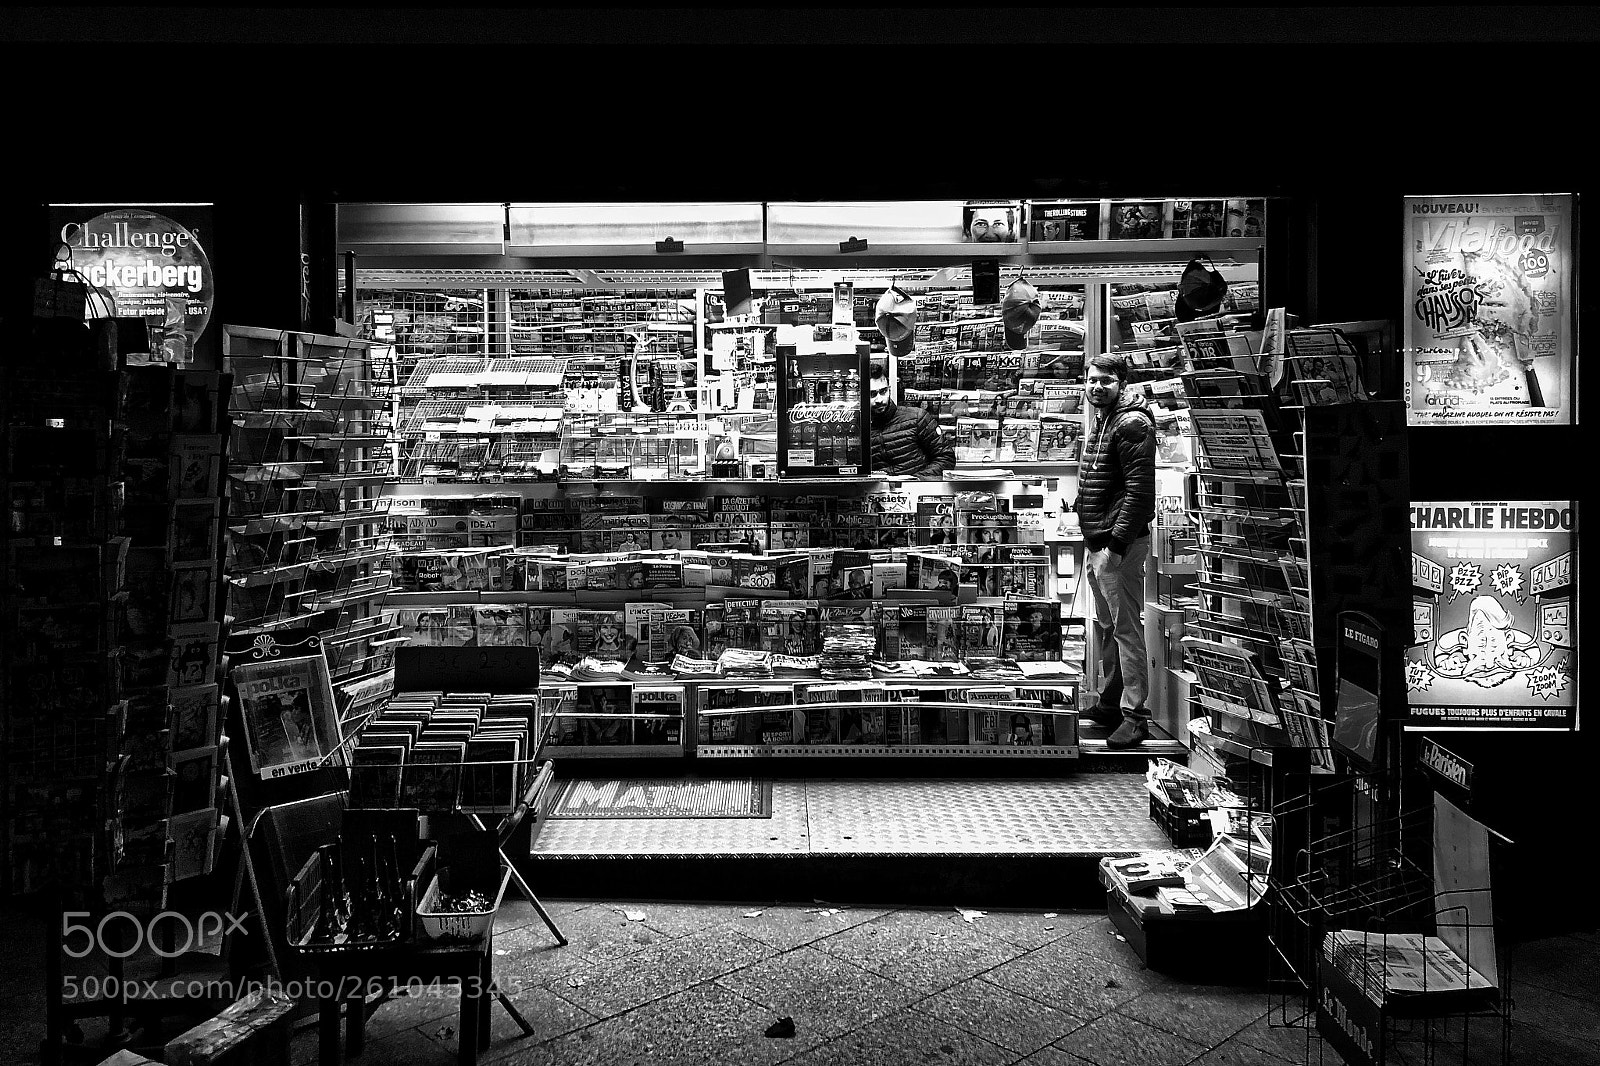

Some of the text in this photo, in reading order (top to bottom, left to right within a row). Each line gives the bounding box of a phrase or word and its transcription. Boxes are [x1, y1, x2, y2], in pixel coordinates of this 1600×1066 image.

[1044, 209, 1087, 218] THE ROLLING STONES
[1412, 203, 1479, 214] NOUVEAU!
[61, 222, 199, 257] Challenges
[1521, 256, 1547, 270] 100
[70, 259, 203, 293] uckerberg
[1417, 285, 1438, 296] dans
[118, 307, 134, 315] Futur
[139, 306, 165, 317] préside
[622, 375, 633, 410] PARIS
[1432, 406, 1466, 419] MAGAZINE
[868, 495, 908, 505] Society
[880, 514, 904, 526] Voici
[1410, 506, 1575, 530] CHARLIE HEBDO
[471, 521, 496, 529] IDEAT
[1458, 568, 1477, 577] BZZ
[751, 577, 769, 588] 300
[1455, 577, 1472, 587] BZZ
[727, 600, 758, 608] DETECTIVE
[1344, 627, 1379, 649] LE FIGARO
[1409, 666, 1426, 676] TUT
[1408, 675, 1423, 685] TUT
[1533, 672, 1557, 684] ZOOM
[1536, 681, 1557, 692] ZOOM
[639, 691, 677, 702] polka
[1410, 707, 1567, 717] FUGUES TOUJOURS PLUS D'ENFANTS EN CAVALE
[271, 766, 285, 777] en
[288, 759, 317, 773] vente
[1430, 744, 1467, 785] Parisien
